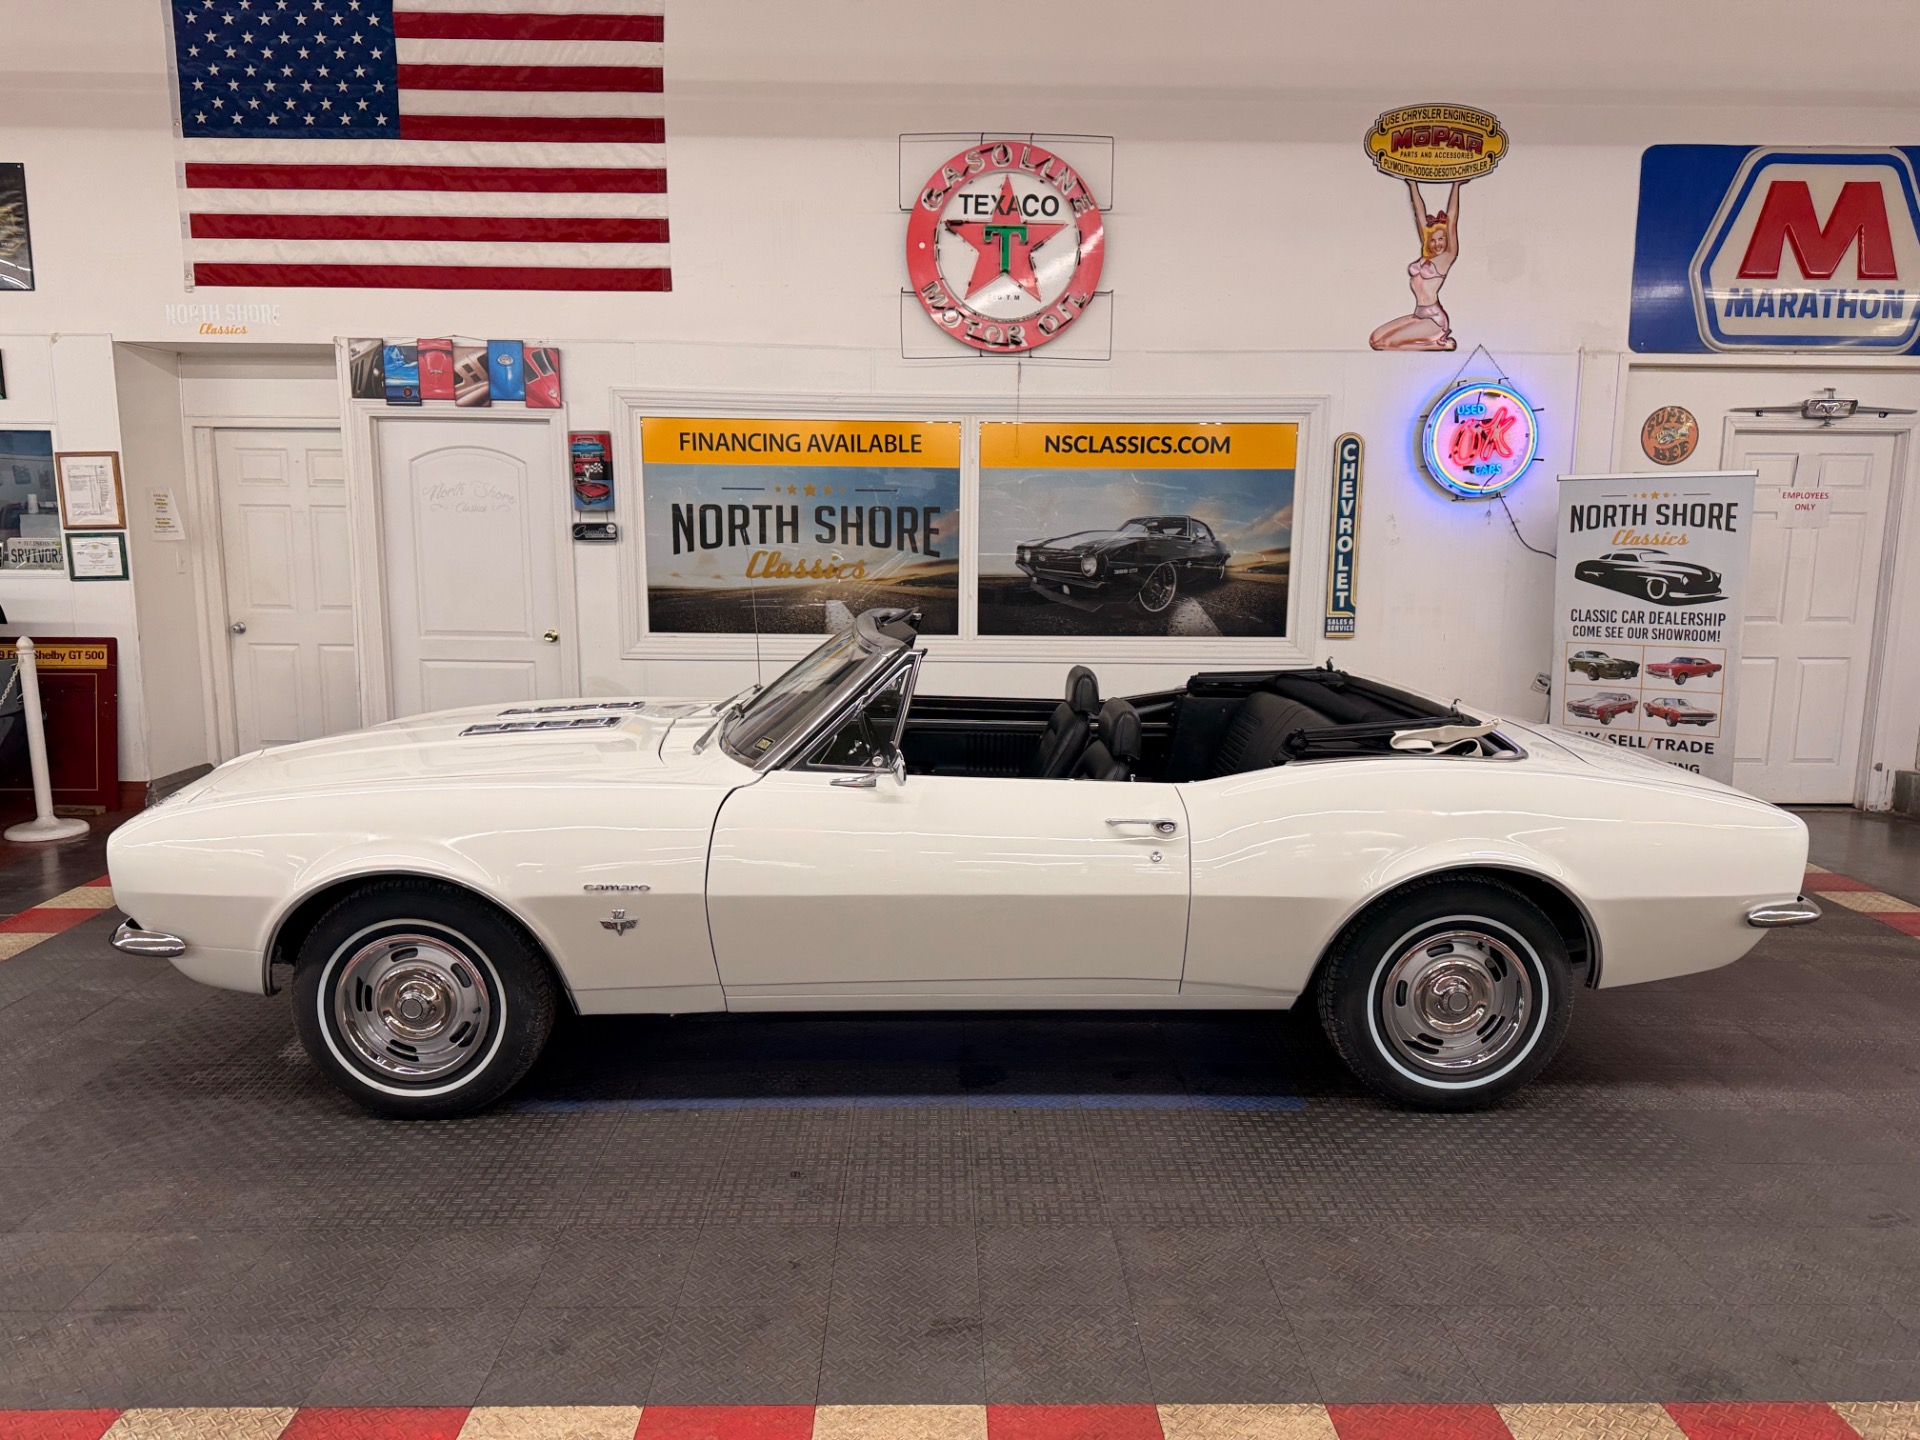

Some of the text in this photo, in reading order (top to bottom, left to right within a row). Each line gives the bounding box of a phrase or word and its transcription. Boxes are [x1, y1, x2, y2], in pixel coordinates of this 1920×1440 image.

[1384, 108, 1491, 127] USE CHRYSLER ENGINEERED
[1400, 151, 1475, 160] PARTS AND ACCESSORIES
[921, 143, 1095, 217] GASOLINE
[958, 193, 1060, 216] TEXACO
[983, 225, 1028, 274] T
[1724, 288, 1905, 319] MARATHON
[165, 303, 281, 327] NORTH SHORE
[921, 281, 1088, 348] MOTOR OIL
[199, 323, 248, 335] Classics
[1457, 404, 1486, 416] USED
[679, 432, 922, 453] FINANCING AVAILABLE
[1045, 435, 1231, 454] NSCLASSICS.COM
[1652, 440, 1690, 462] BEE
[1474, 464, 1502, 475] CARS
[1782, 491, 1829, 499] EMPLOYEES
[1794, 503, 1816, 511] ONLY
[1336, 443, 1358, 608] CHEVROLET
[1570, 502, 1738, 533] NORTH SHORE
[672, 503, 941, 558] NORTH SHORE
[1611, 529, 1690, 546] Classics
[11, 548, 58, 563] SRVIVOR
[745, 549, 868, 580] Classics
[1570, 608, 1726, 627] CLASSIC CAR DEALERSHIP
[1572, 625, 1721, 642] COME SEE OUR SHOWROOM!
[68, 650, 83, 660] GT
[85, 650, 105, 660] 500
